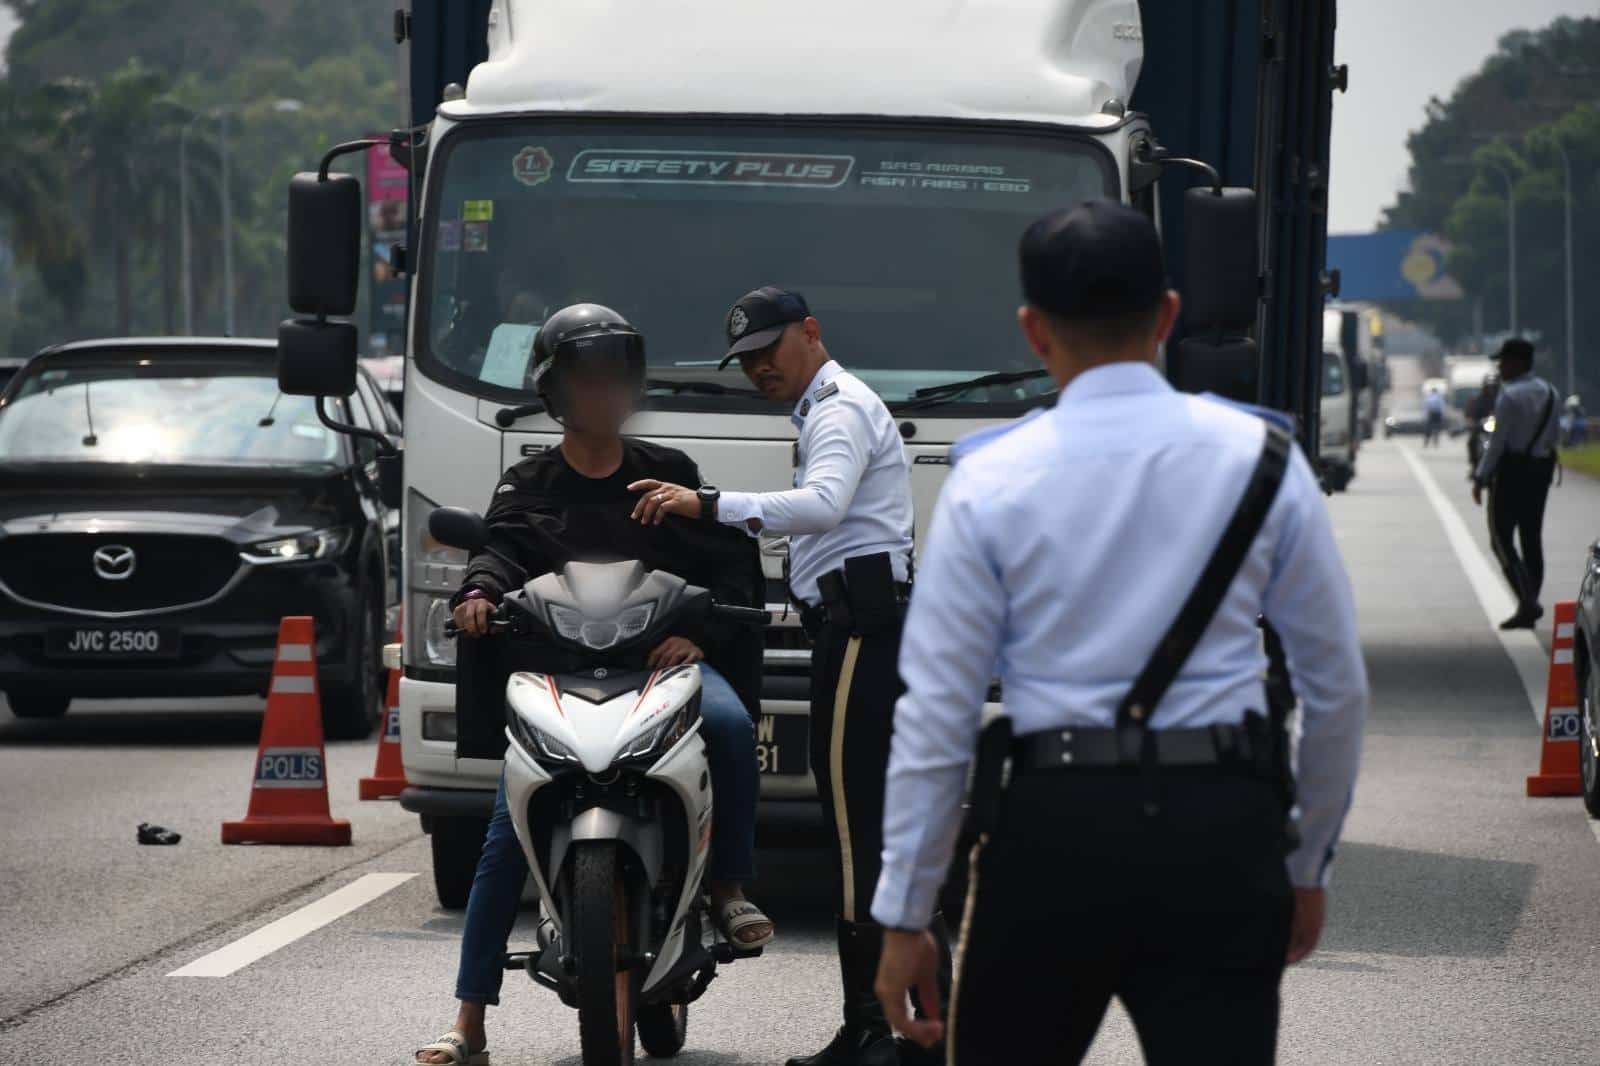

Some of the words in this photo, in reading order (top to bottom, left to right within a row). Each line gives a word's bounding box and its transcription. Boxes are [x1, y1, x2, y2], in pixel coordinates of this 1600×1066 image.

[584, 159, 730, 175] SAFETY
[734, 161, 836, 178] PLUS
[921, 179, 967, 190] ABS
[983, 182, 1030, 192] EBD
[68, 630, 104, 651] JVC
[109, 630, 158, 651] 2500
[261, 757, 320, 778] POLIS
